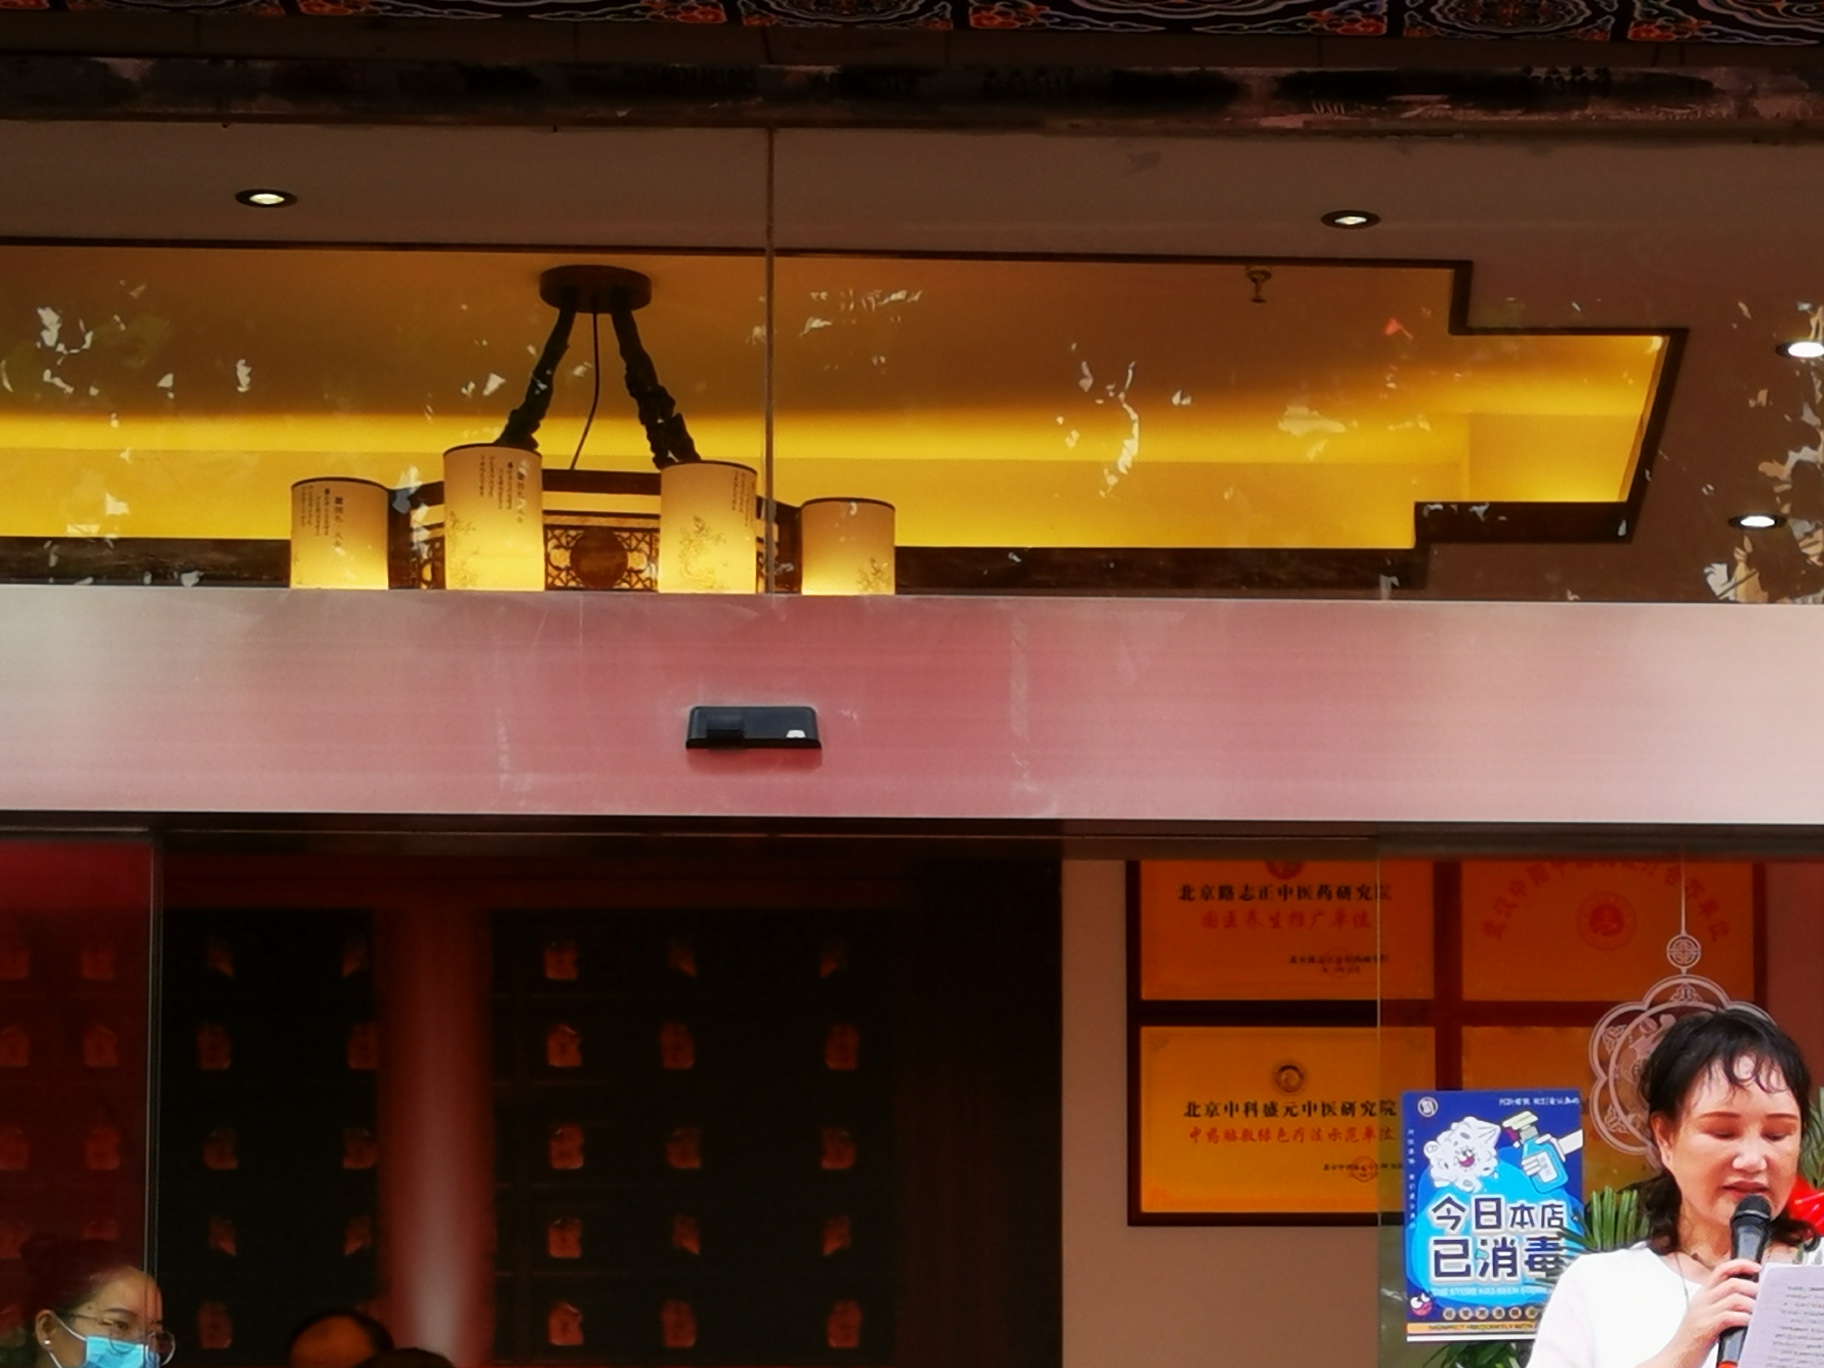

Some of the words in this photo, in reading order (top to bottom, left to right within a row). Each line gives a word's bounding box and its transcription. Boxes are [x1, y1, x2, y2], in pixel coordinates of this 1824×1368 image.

[1183, 1100, 1398, 1118] 北京中科盛元中医研究院
[1432, 1195, 1565, 1231] 今日本店
[1432, 1236, 1565, 1278] 已消毒
